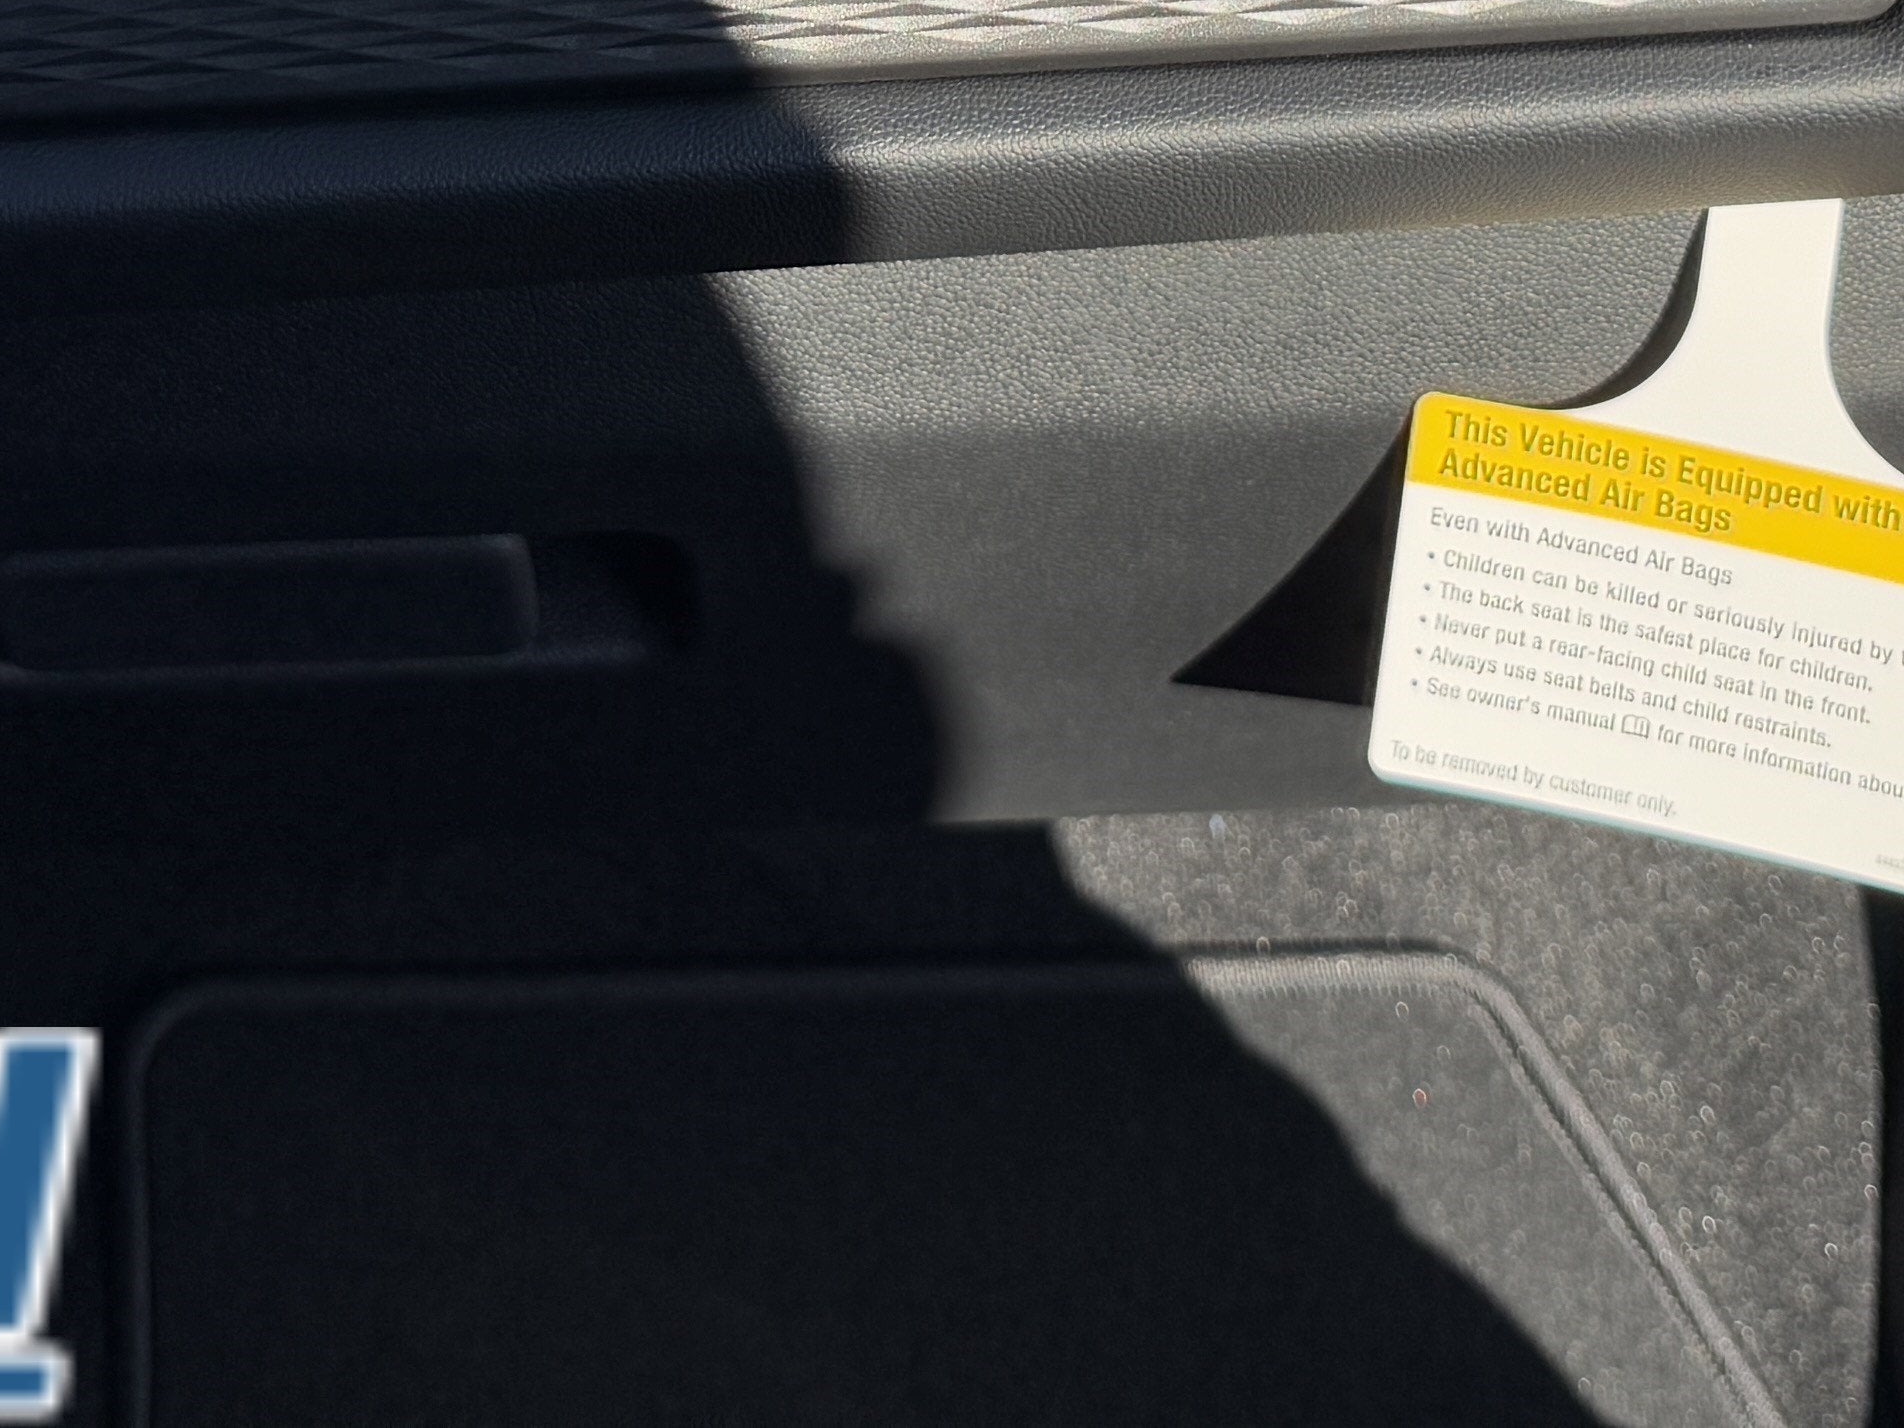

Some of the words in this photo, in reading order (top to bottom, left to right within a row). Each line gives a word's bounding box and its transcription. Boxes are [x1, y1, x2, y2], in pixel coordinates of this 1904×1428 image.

[1437, 447, 1592, 502] Advanced
[1598, 477, 1646, 519] Air
[1654, 488, 1732, 537] Bags
[1445, 409, 1509, 448] This
[1519, 422, 1631, 472] Vehicle
[1639, 446, 1667, 479] is
[1675, 454, 1824, 514] Equipped
[1833, 494, 1901, 532] with
[1429, 505, 1480, 535] Even
[1485, 519, 1531, 545] with
[1535, 526, 1640, 566] Advanced
[1643, 548, 1677, 574] Air
[1680, 555, 1734, 588] Bags
[1438, 579, 1474, 606] The
[1478, 588, 1525, 616] back
[1530, 601, 1573, 625] seat
[1575, 606, 1594, 629] is
[1598, 612, 1631, 637] the
[1633, 622, 1696, 651] safest
[1697, 635, 1752, 664] place
[1756, 646, 1787, 671] for
[1788, 656, 1874, 694] children.
[1442, 548, 1526, 581] Children
[1531, 569, 1569, 591] can
[1573, 573, 1600, 596] be
[1604, 580, 1661, 611] killed
[1666, 597, 1690, 618] or
[1692, 602, 1787, 643] seriously
[1790, 620, 1866, 657] injured
[1868, 639, 1895, 667] by
[1428, 644, 1499, 677] Always
[1502, 661, 1538, 683] use
[1542, 669, 1587, 697] seat
[1588, 675, 1637, 705] belts
[1640, 690, 1679, 714] and
[1681, 697, 1731, 725] child
[1733, 711, 1832, 749] restraints.
[1433, 611, 1492, 641] Never
[1494, 627, 1528, 649] put
[1530, 634, 1545, 652] a
[1547, 638, 1658, 683] rear-facing
[1659, 660, 1710, 689] child
[1711, 673, 1756, 699] seat
[1758, 679, 1779, 705] in
[1783, 687, 1817, 714] the
[1820, 694, 1872, 725] front.
[1390, 738, 1413, 765] To
[1413, 743, 1440, 771] be
[1439, 751, 1521, 787] removed
[1521, 764, 1546, 795] by
[1547, 773, 1634, 809] customer
[1635, 792, 1678, 821] only.
[1425, 675, 1462, 701] See
[1465, 686, 1542, 716] owner's
[1545, 703, 1618, 733] manual
[1656, 723, 1686, 747] for
[1687, 733, 1738, 759] more
[1742, 741, 1853, 787] information
